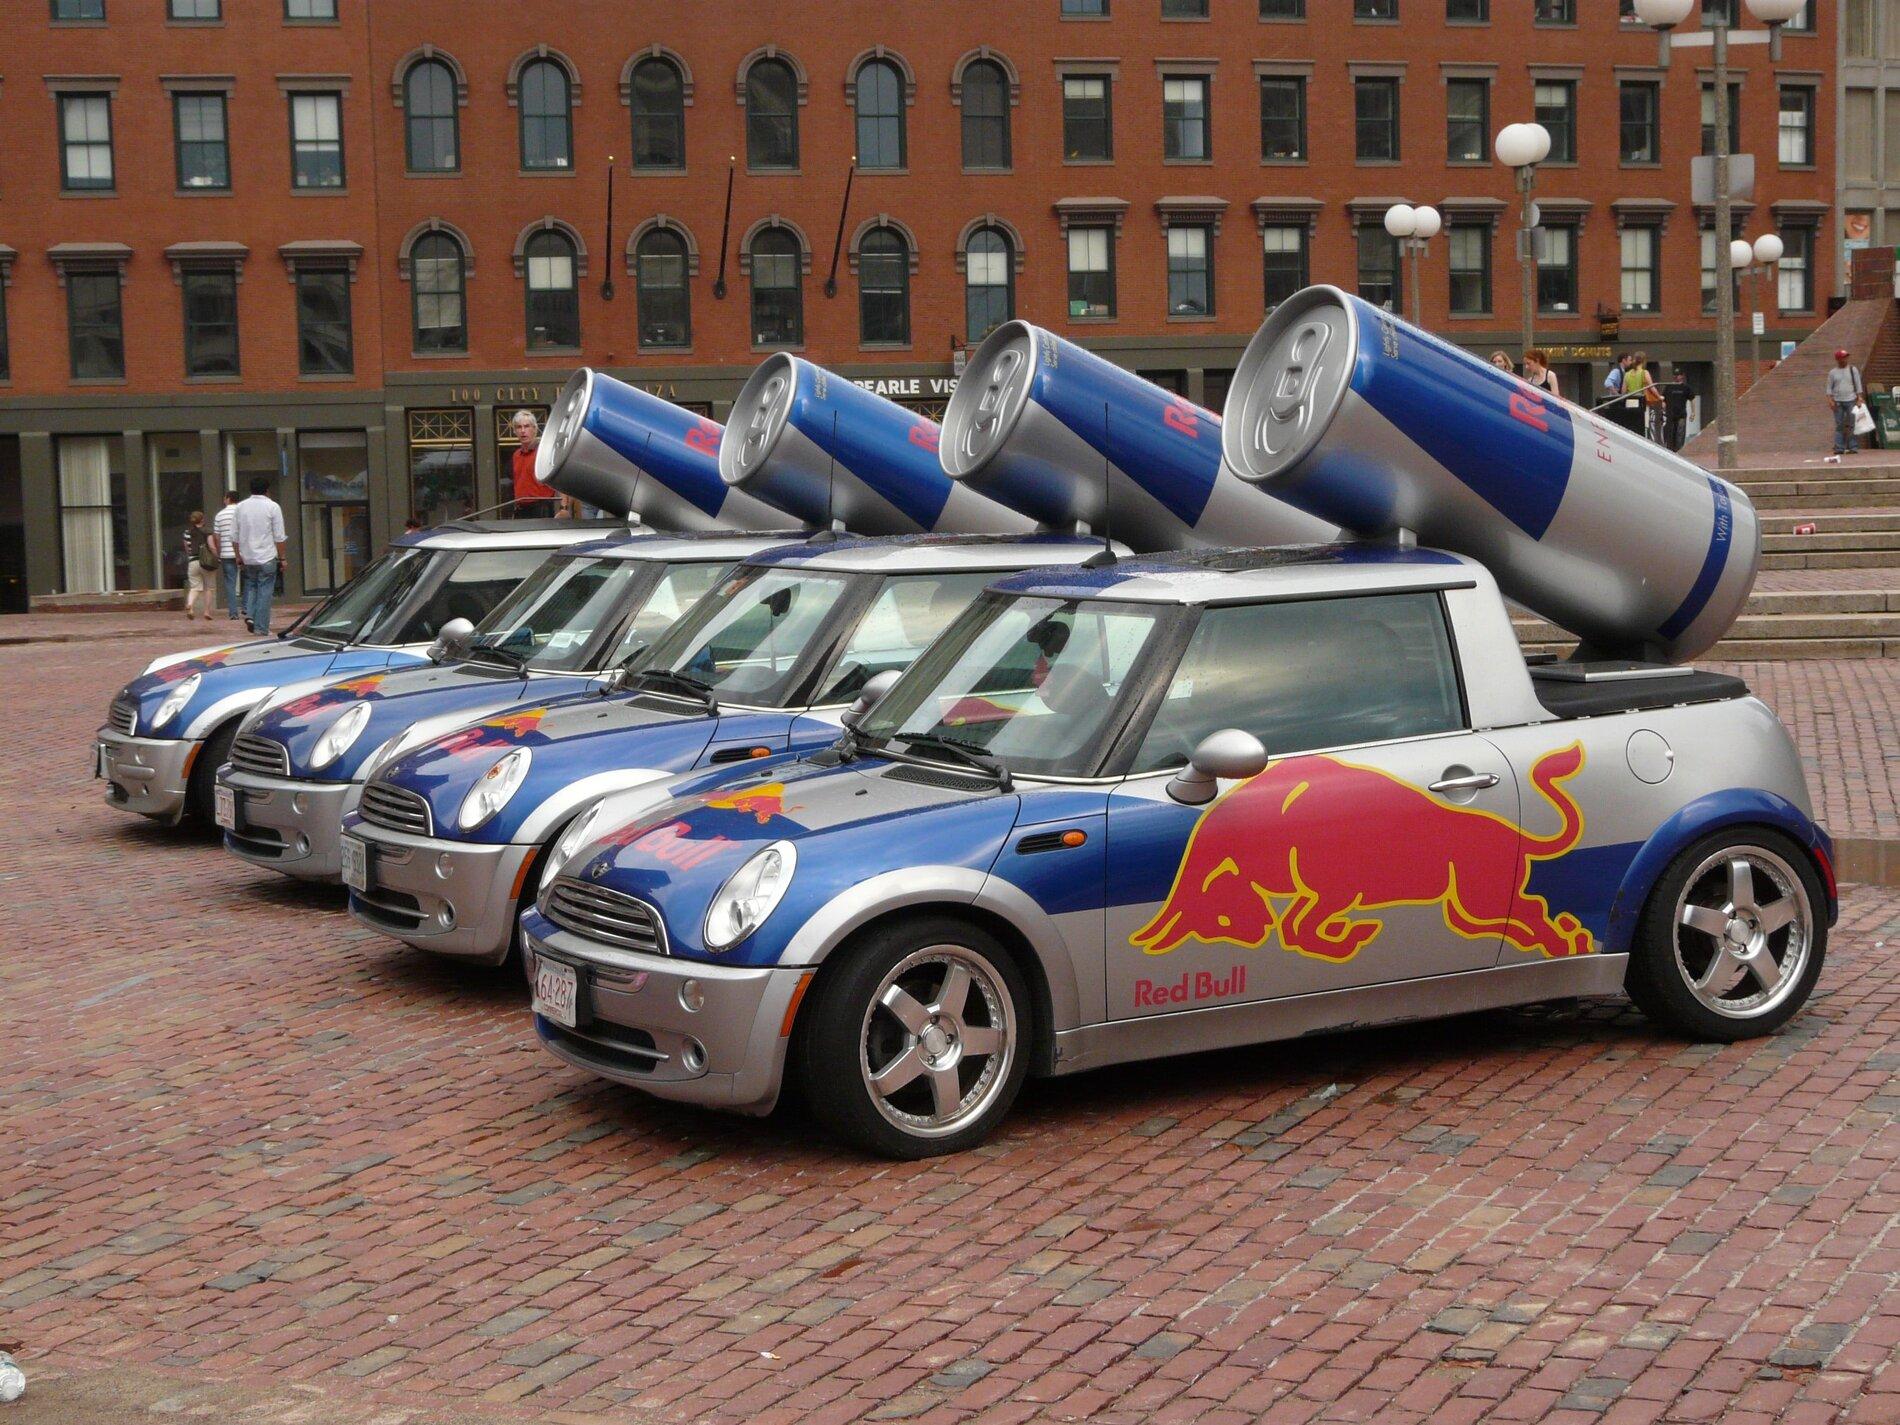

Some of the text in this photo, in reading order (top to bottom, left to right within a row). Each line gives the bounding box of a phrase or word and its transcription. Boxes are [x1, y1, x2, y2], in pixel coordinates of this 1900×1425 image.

[1571, 346, 1612, 358] DONUTS
[930, 379, 959, 394] VIS
[450, 388, 481, 402] 100
[497, 387, 541, 402] CITY
[1715, 515, 1728, 541] With
[1134, 965, 1247, 1008] Red Bull
